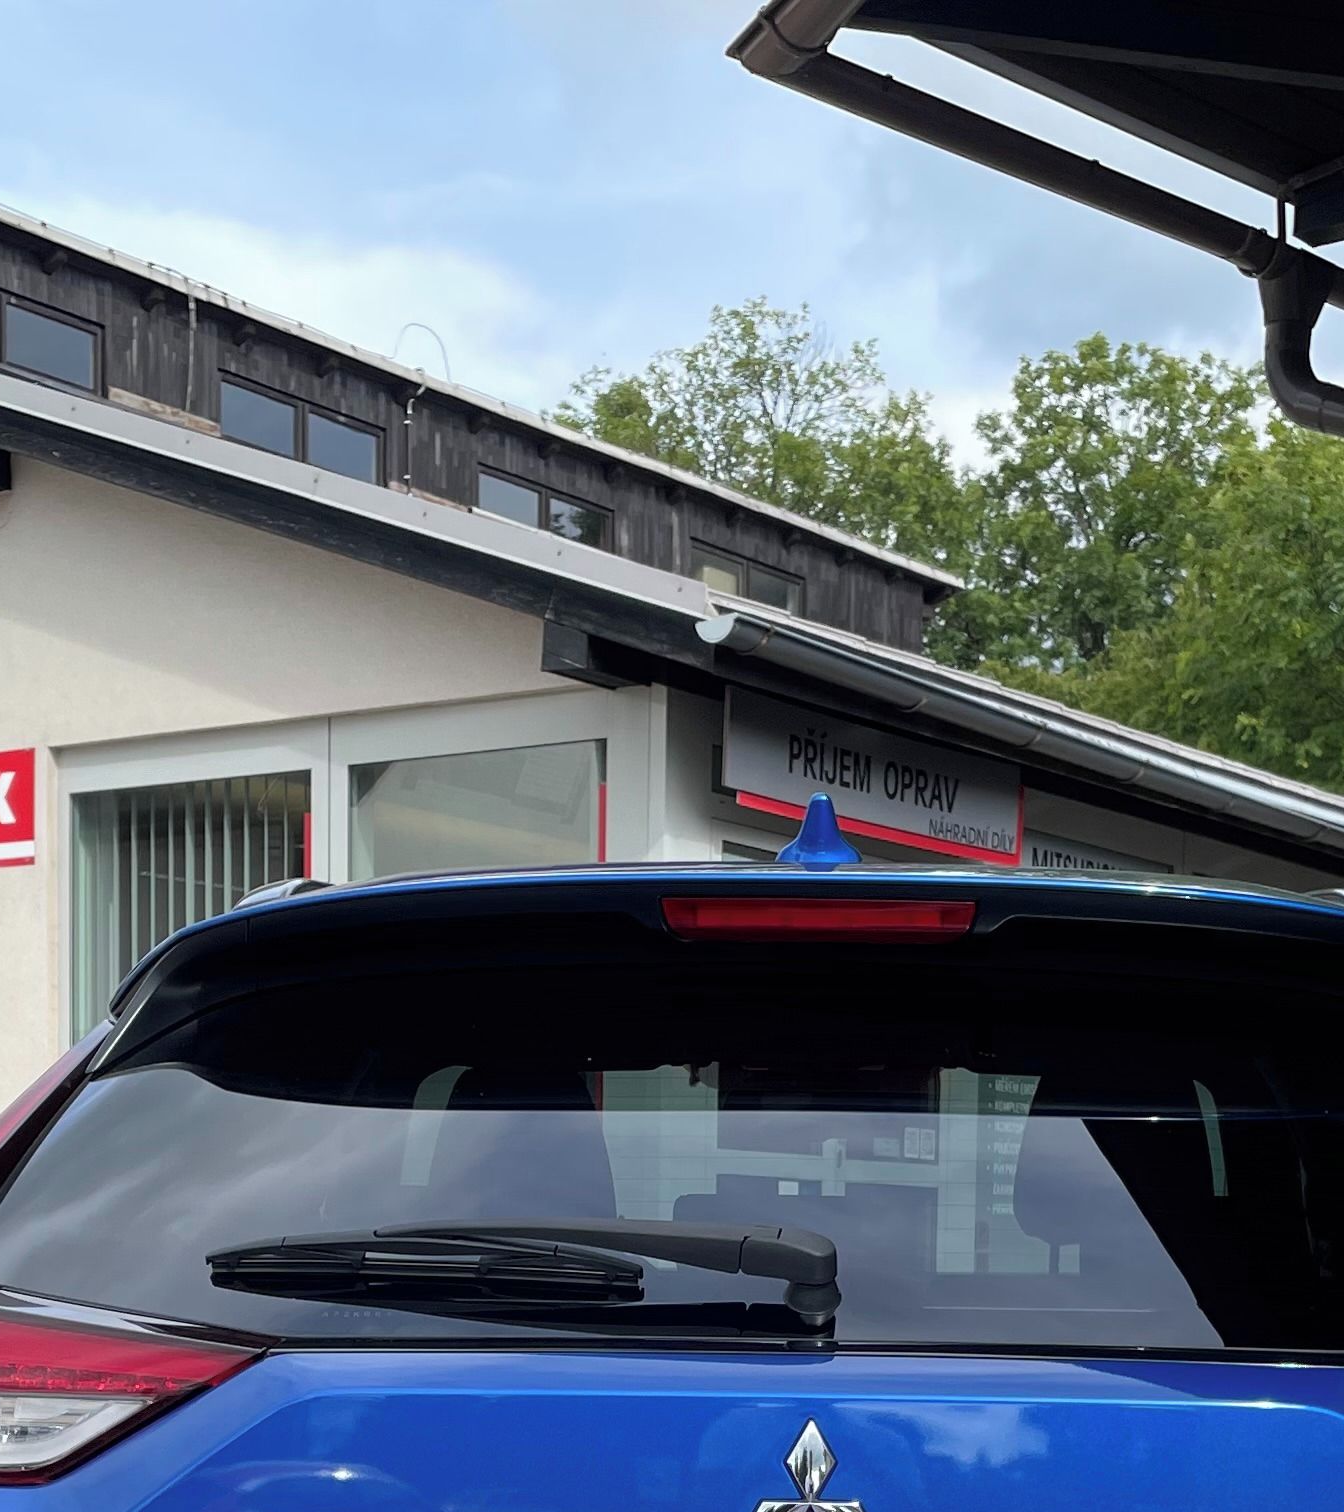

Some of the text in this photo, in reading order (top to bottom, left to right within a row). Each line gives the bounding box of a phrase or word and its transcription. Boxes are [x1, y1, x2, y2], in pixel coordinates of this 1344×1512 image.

[788, 727, 960, 813] PŘÍJEM OPRAV
[929, 815, 1015, 852] NÁHRADNÍ DÍLY
